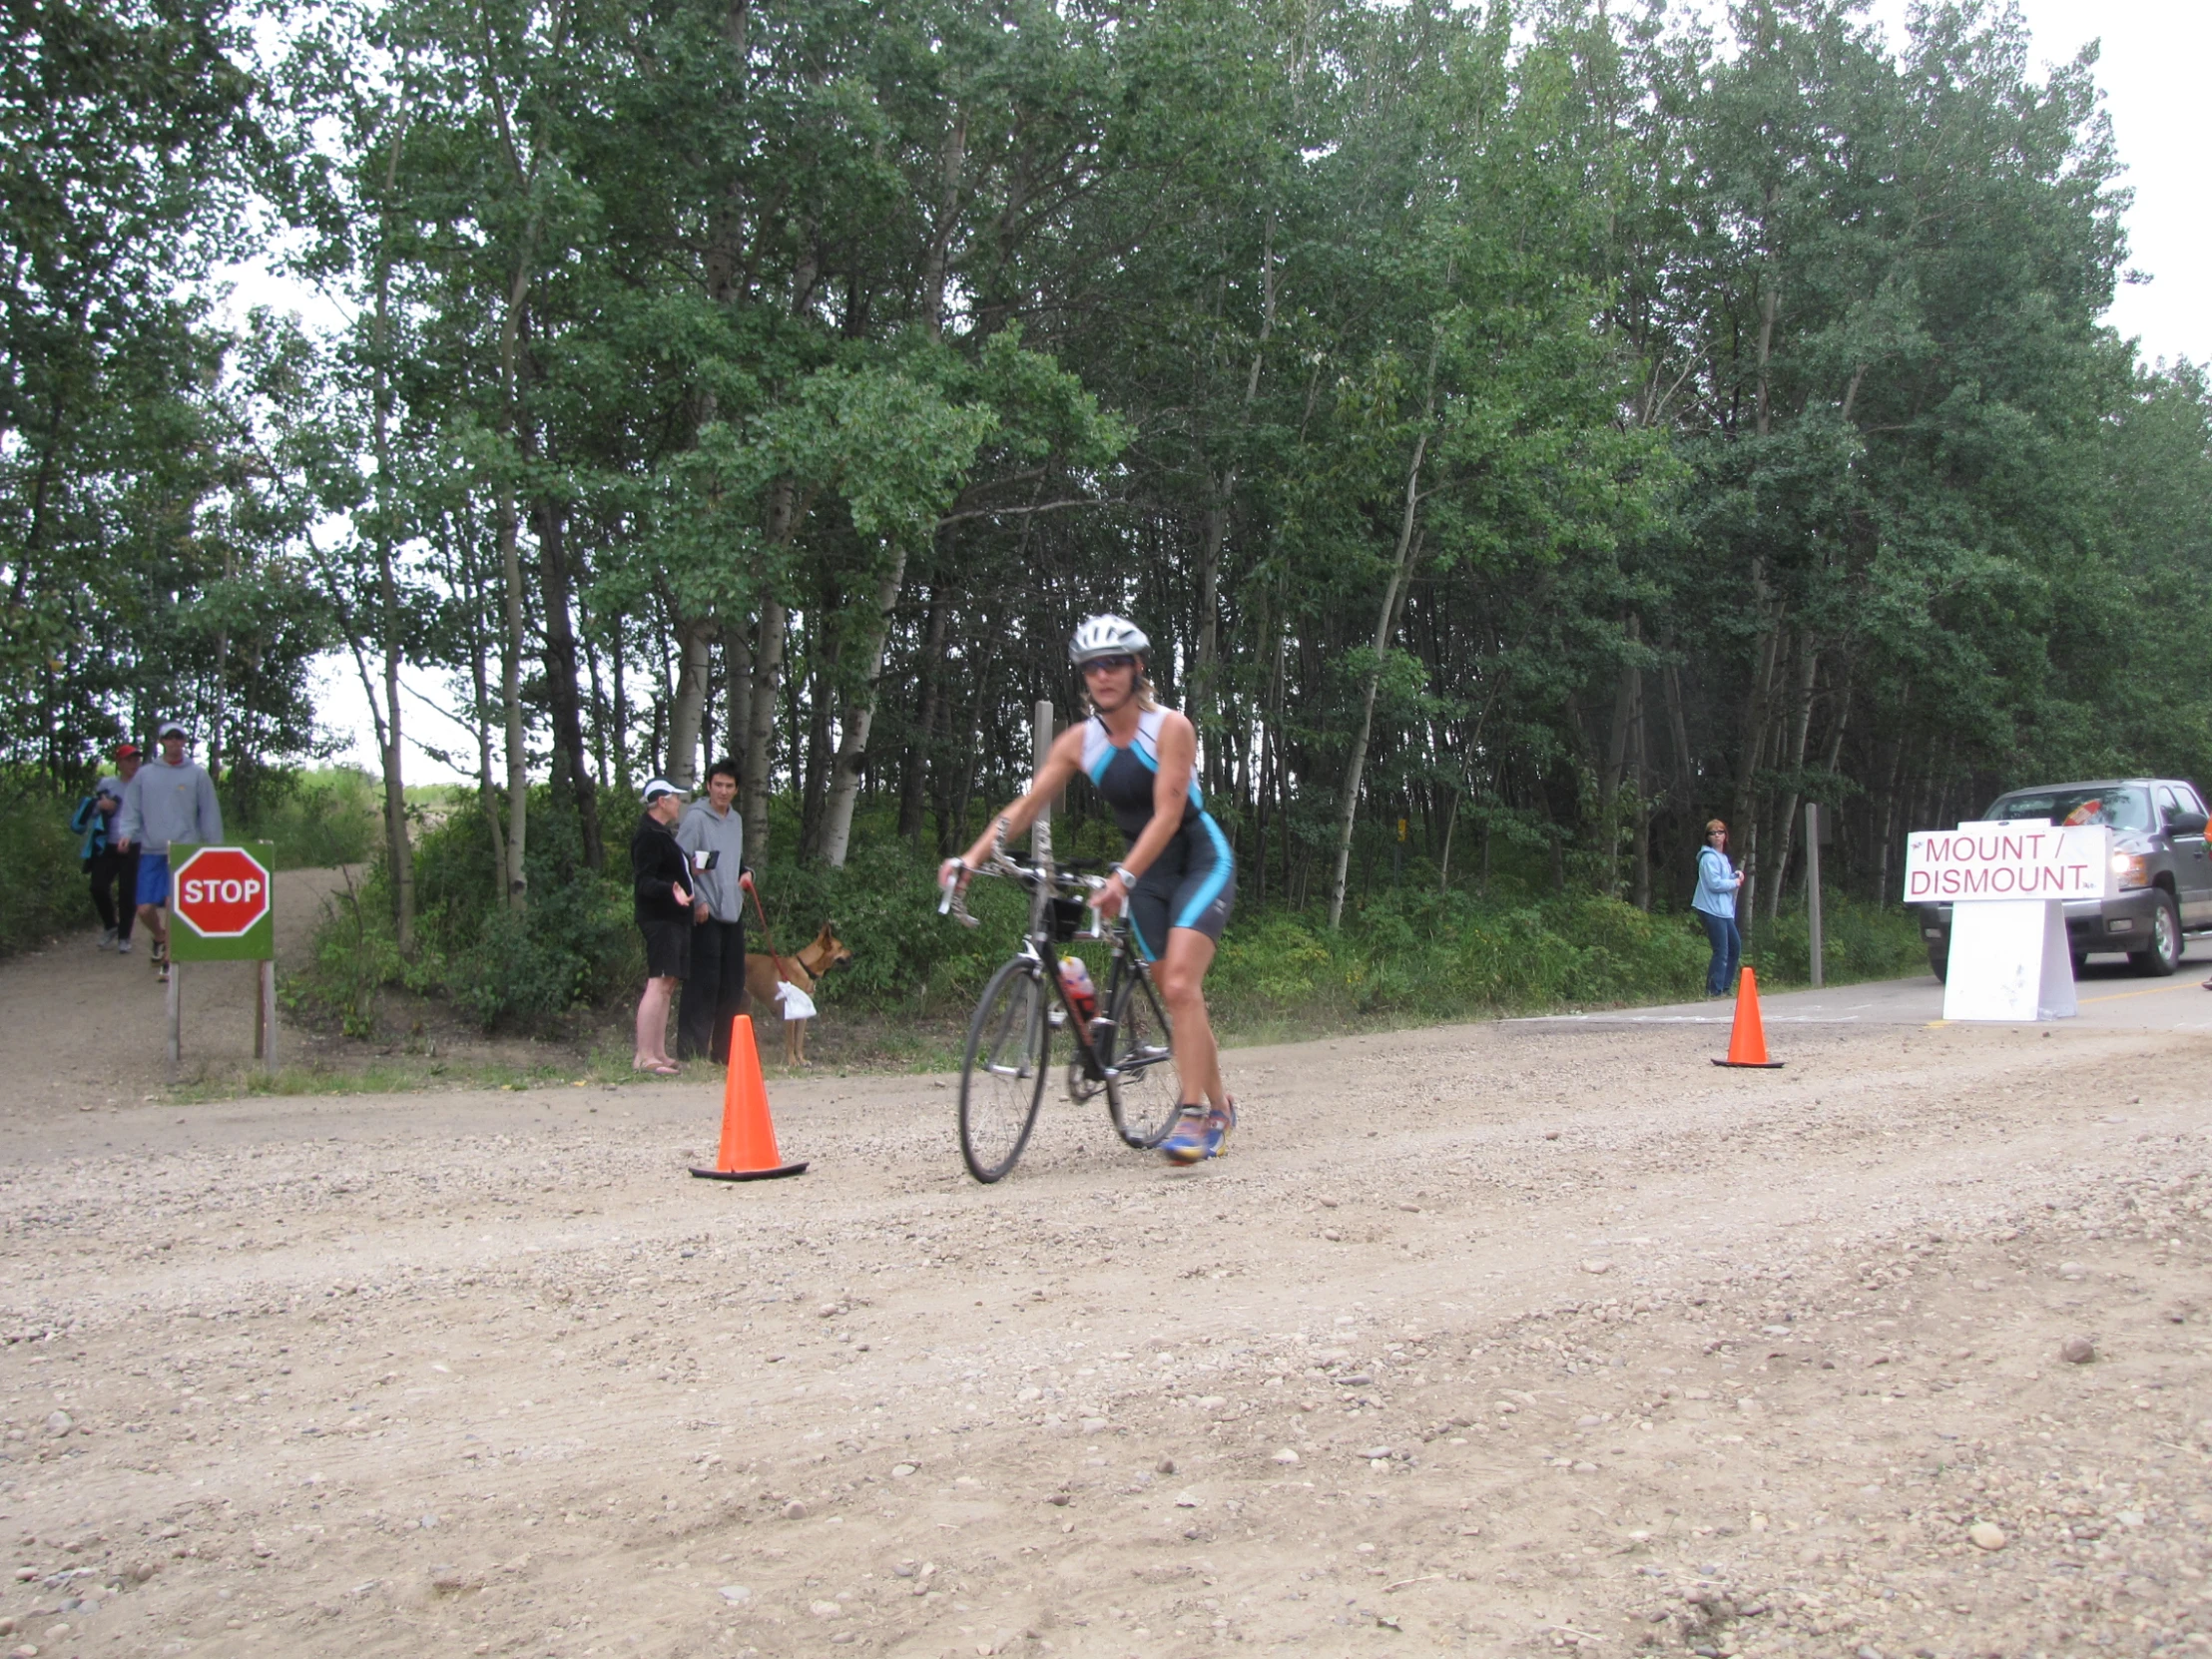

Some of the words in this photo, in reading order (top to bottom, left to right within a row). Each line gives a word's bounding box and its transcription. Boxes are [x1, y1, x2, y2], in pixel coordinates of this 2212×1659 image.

[1926, 834, 2045, 861] MOUNT
[185, 879, 261, 903] STOP
[1911, 864, 2088, 894] DISMOUNT
